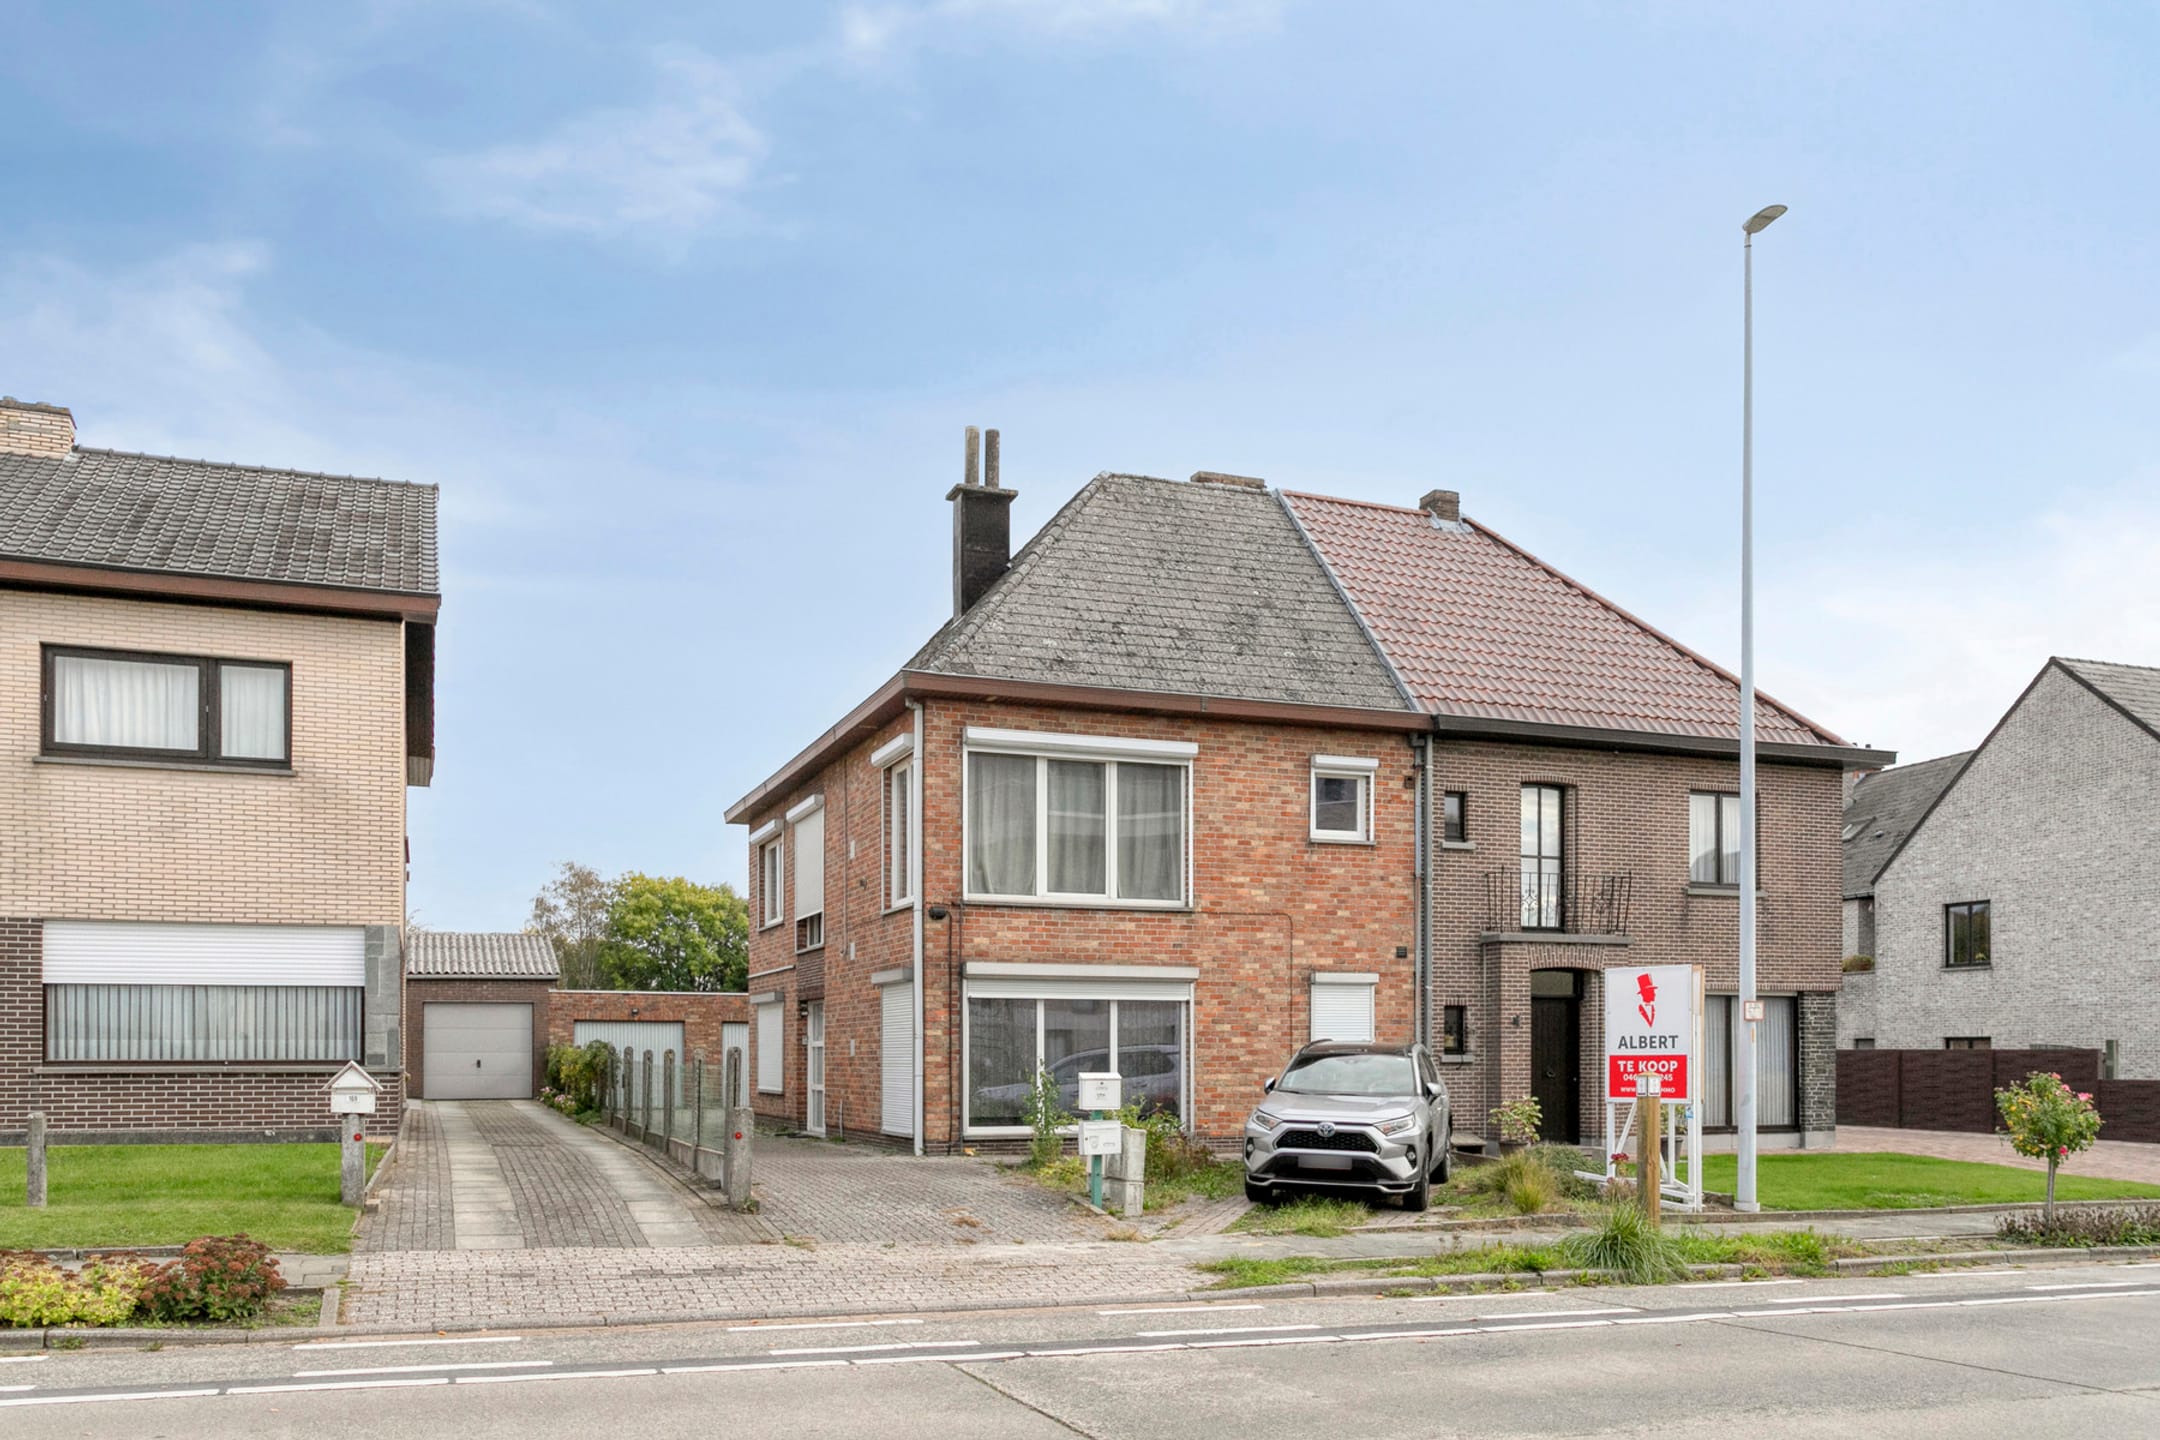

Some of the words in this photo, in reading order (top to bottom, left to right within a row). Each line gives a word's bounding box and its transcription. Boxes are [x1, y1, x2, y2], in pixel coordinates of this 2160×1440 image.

[1618, 1035, 1679, 1049] ALBERT
[1617, 1060, 1635, 1072] TE
[1638, 1060, 1678, 1072] KOOP
